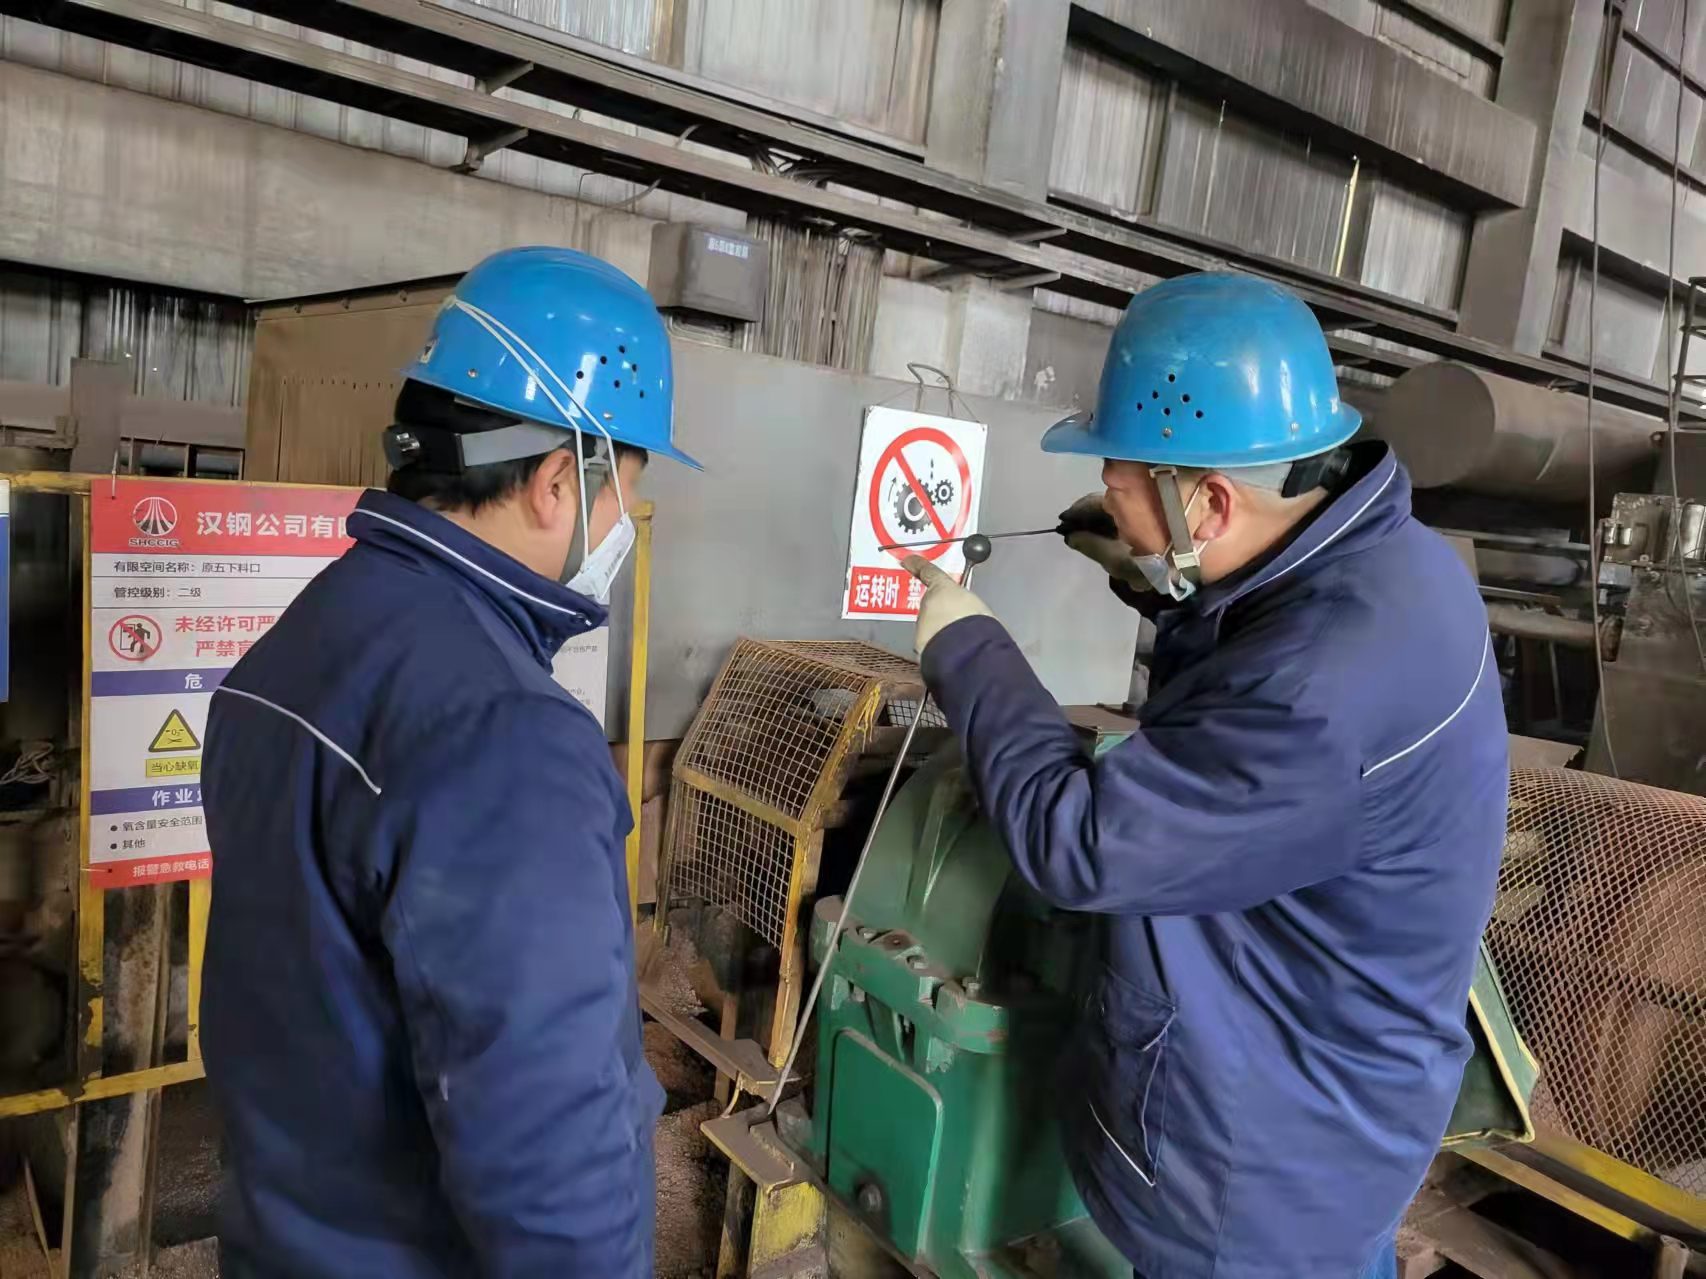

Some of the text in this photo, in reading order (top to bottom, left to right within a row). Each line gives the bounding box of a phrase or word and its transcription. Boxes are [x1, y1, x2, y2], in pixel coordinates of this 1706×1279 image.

[128, 537, 180, 548] SHCCIG
[855, 573, 900, 608] 运转时
[184, 673, 203, 690] 危
[151, 760, 200, 773] 当心缺氧
[122, 838, 146, 850] 其他
[132, 858, 210, 878] 报警急救电话
